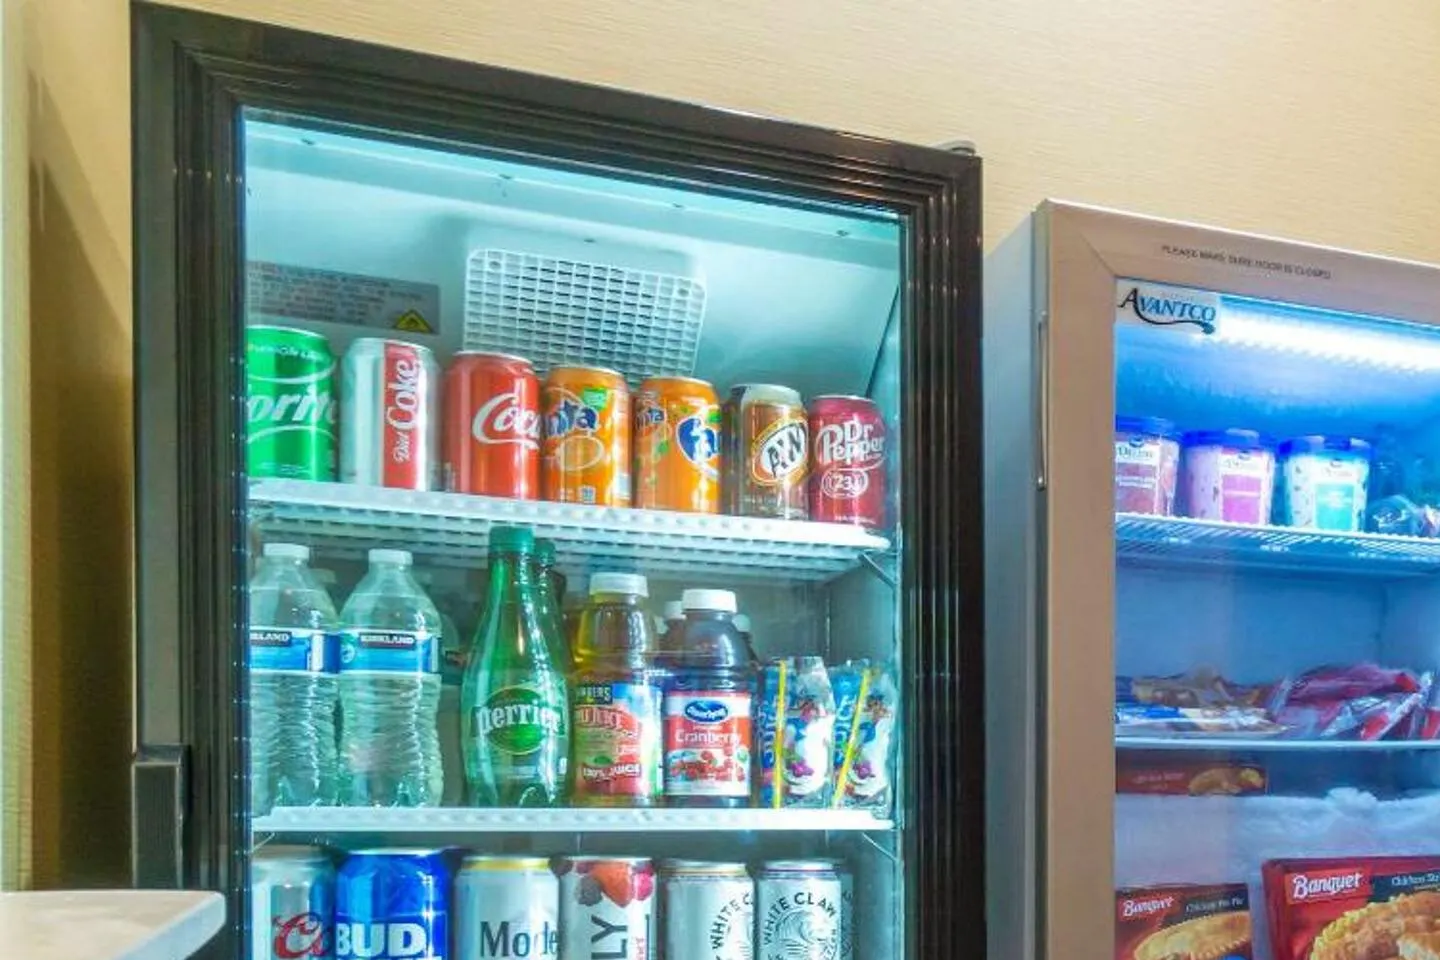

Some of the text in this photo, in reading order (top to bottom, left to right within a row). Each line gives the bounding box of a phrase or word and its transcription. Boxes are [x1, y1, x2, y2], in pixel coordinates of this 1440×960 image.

[247, 382, 335, 424] prit
[386, 358, 420, 430] Coke
[821, 426, 885, 464] Pepper
[843, 420, 875, 442] Dr
[1293, 872, 1362, 900] Banquet
[711, 899, 743, 951] WHITE
[763, 890, 837, 945] WHITE CLAW
[335, 922, 427, 957] BUD
[479, 920, 557, 959] Mode
